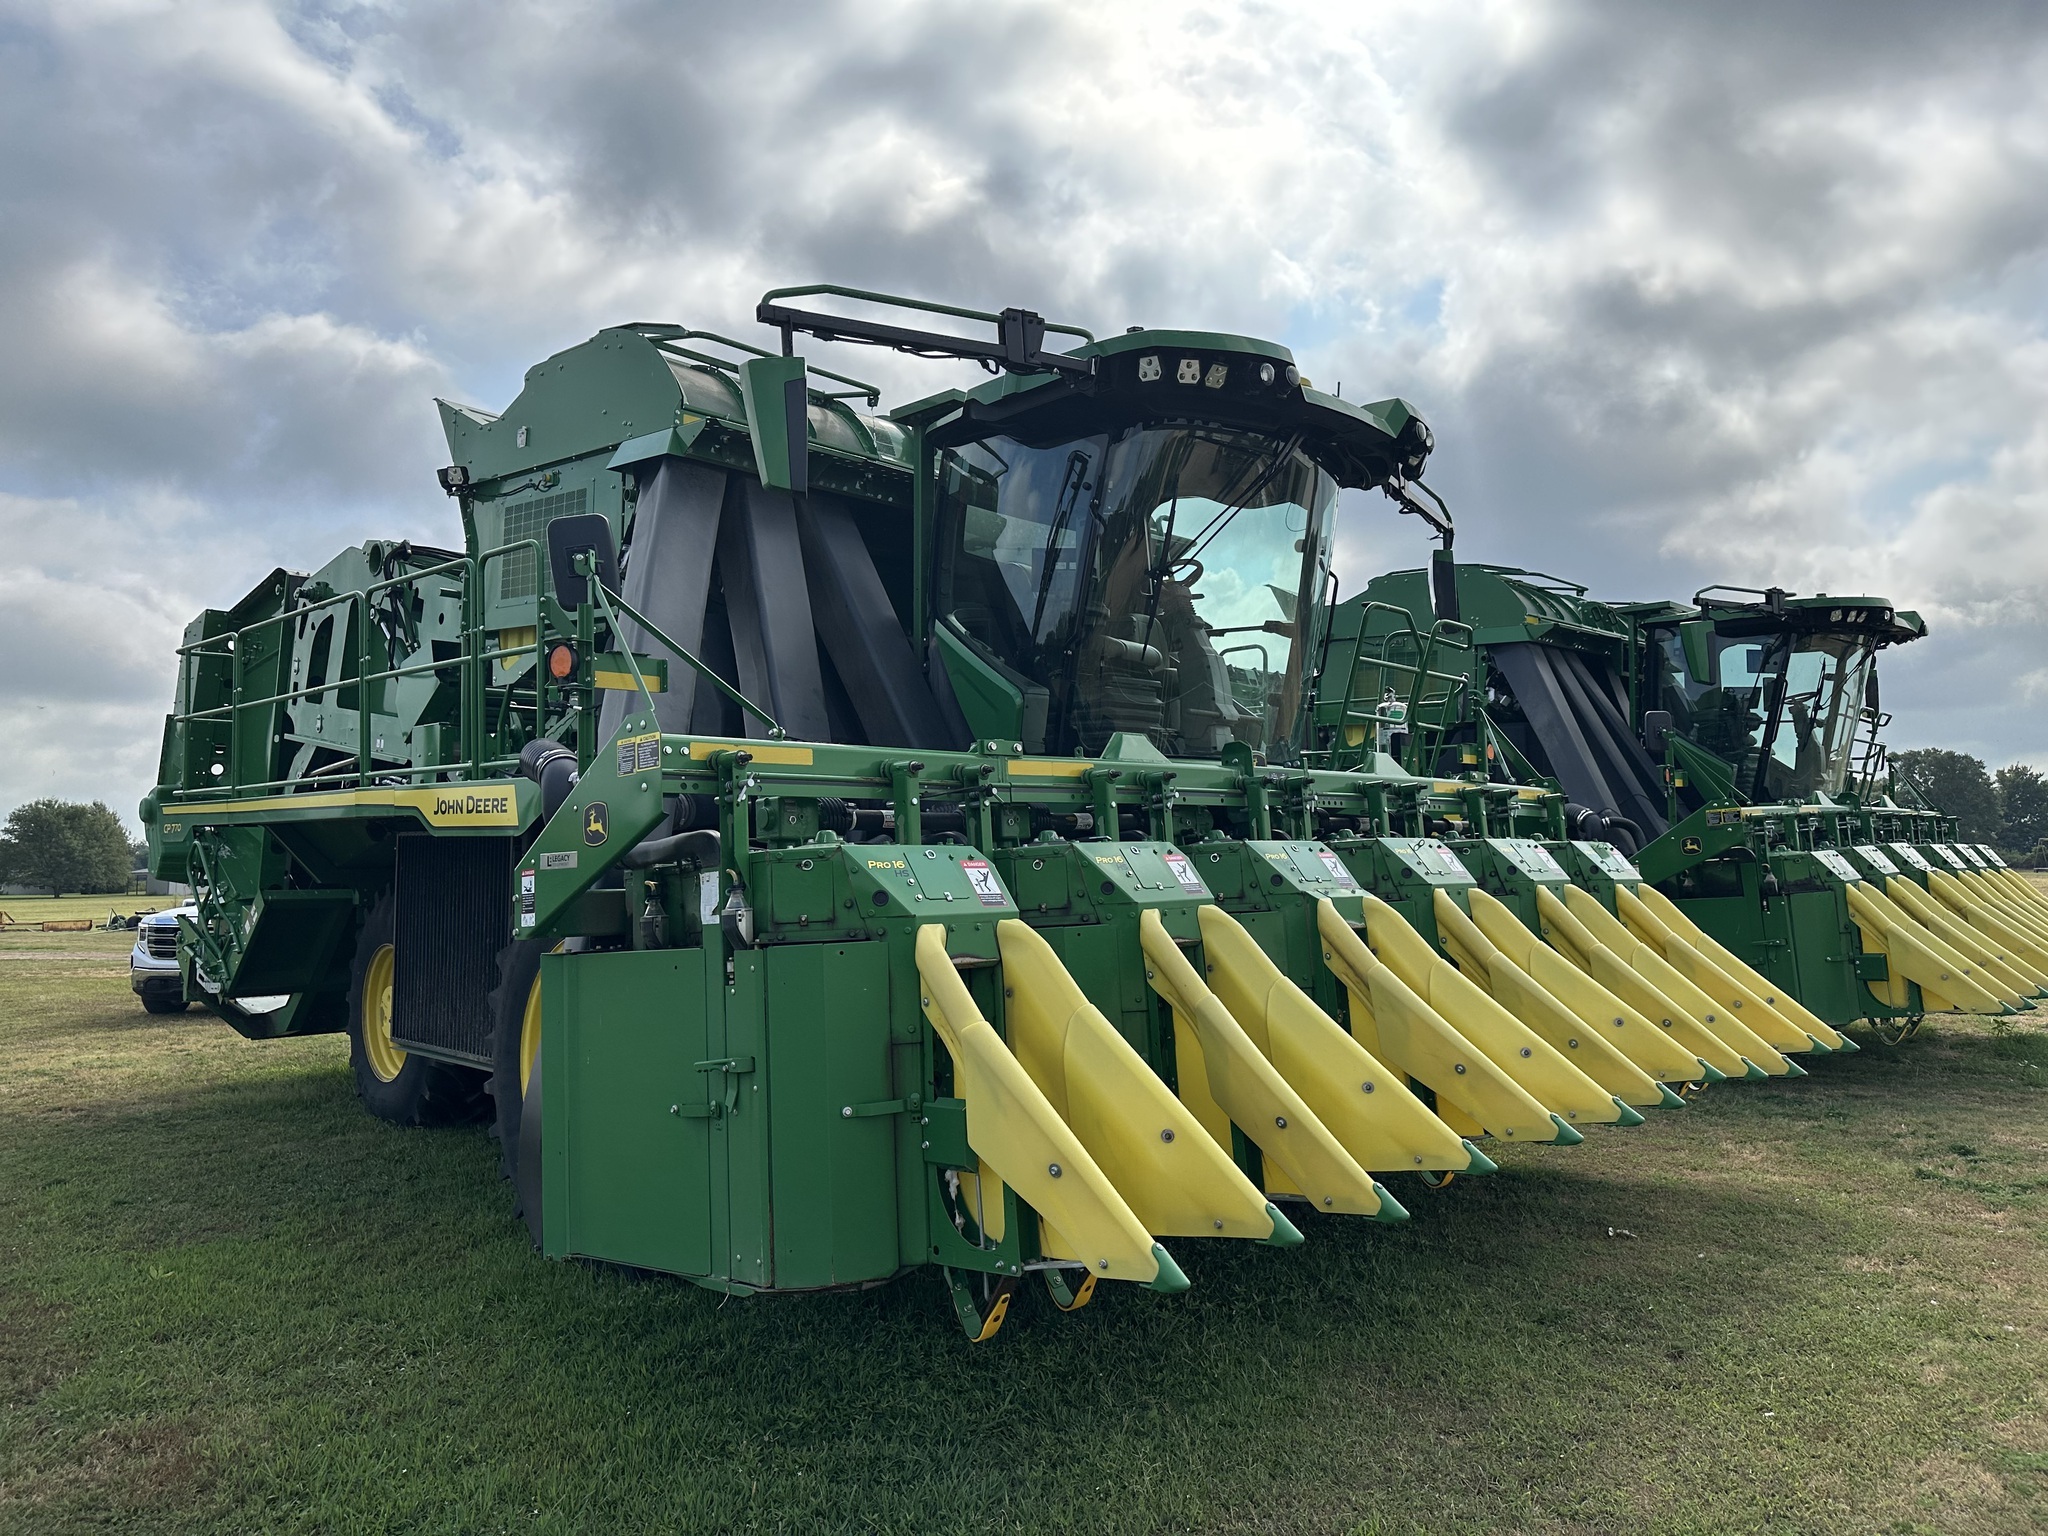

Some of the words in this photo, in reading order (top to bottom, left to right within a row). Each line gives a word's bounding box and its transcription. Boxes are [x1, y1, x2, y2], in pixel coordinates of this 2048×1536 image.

[433, 797, 464, 815] JOHN
[466, 795, 508, 814] DEERE
[552, 854, 570, 863] LEGACY
[891, 860, 906, 869] 16
